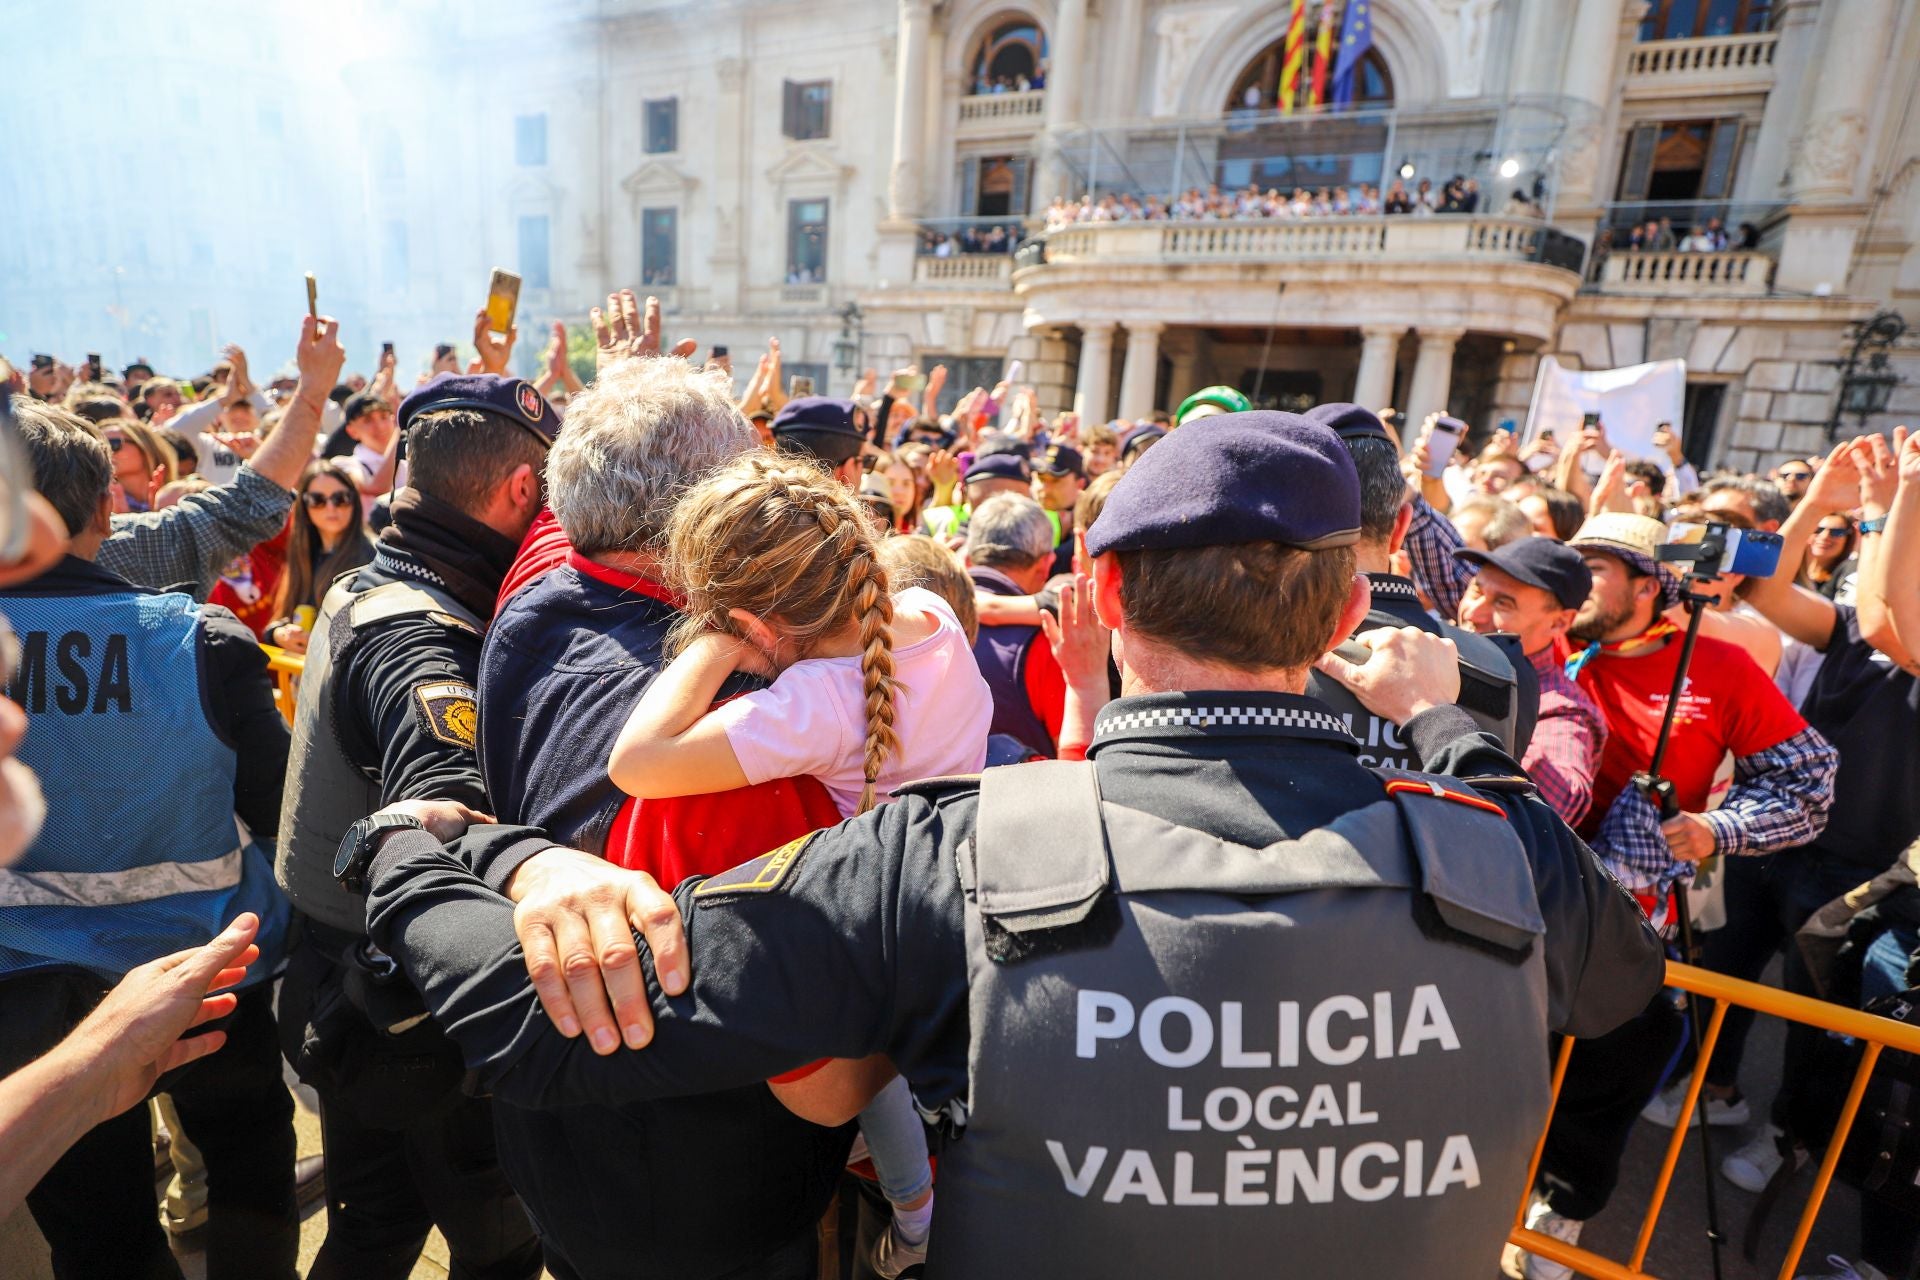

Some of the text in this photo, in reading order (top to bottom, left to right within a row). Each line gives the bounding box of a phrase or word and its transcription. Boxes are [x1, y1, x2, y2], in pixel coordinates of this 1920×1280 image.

[1076, 984, 1461, 1068] POLICIA
[1168, 1081, 1378, 1132] LOCAL
[1045, 1134, 1481, 1206] VALÈNCIA
